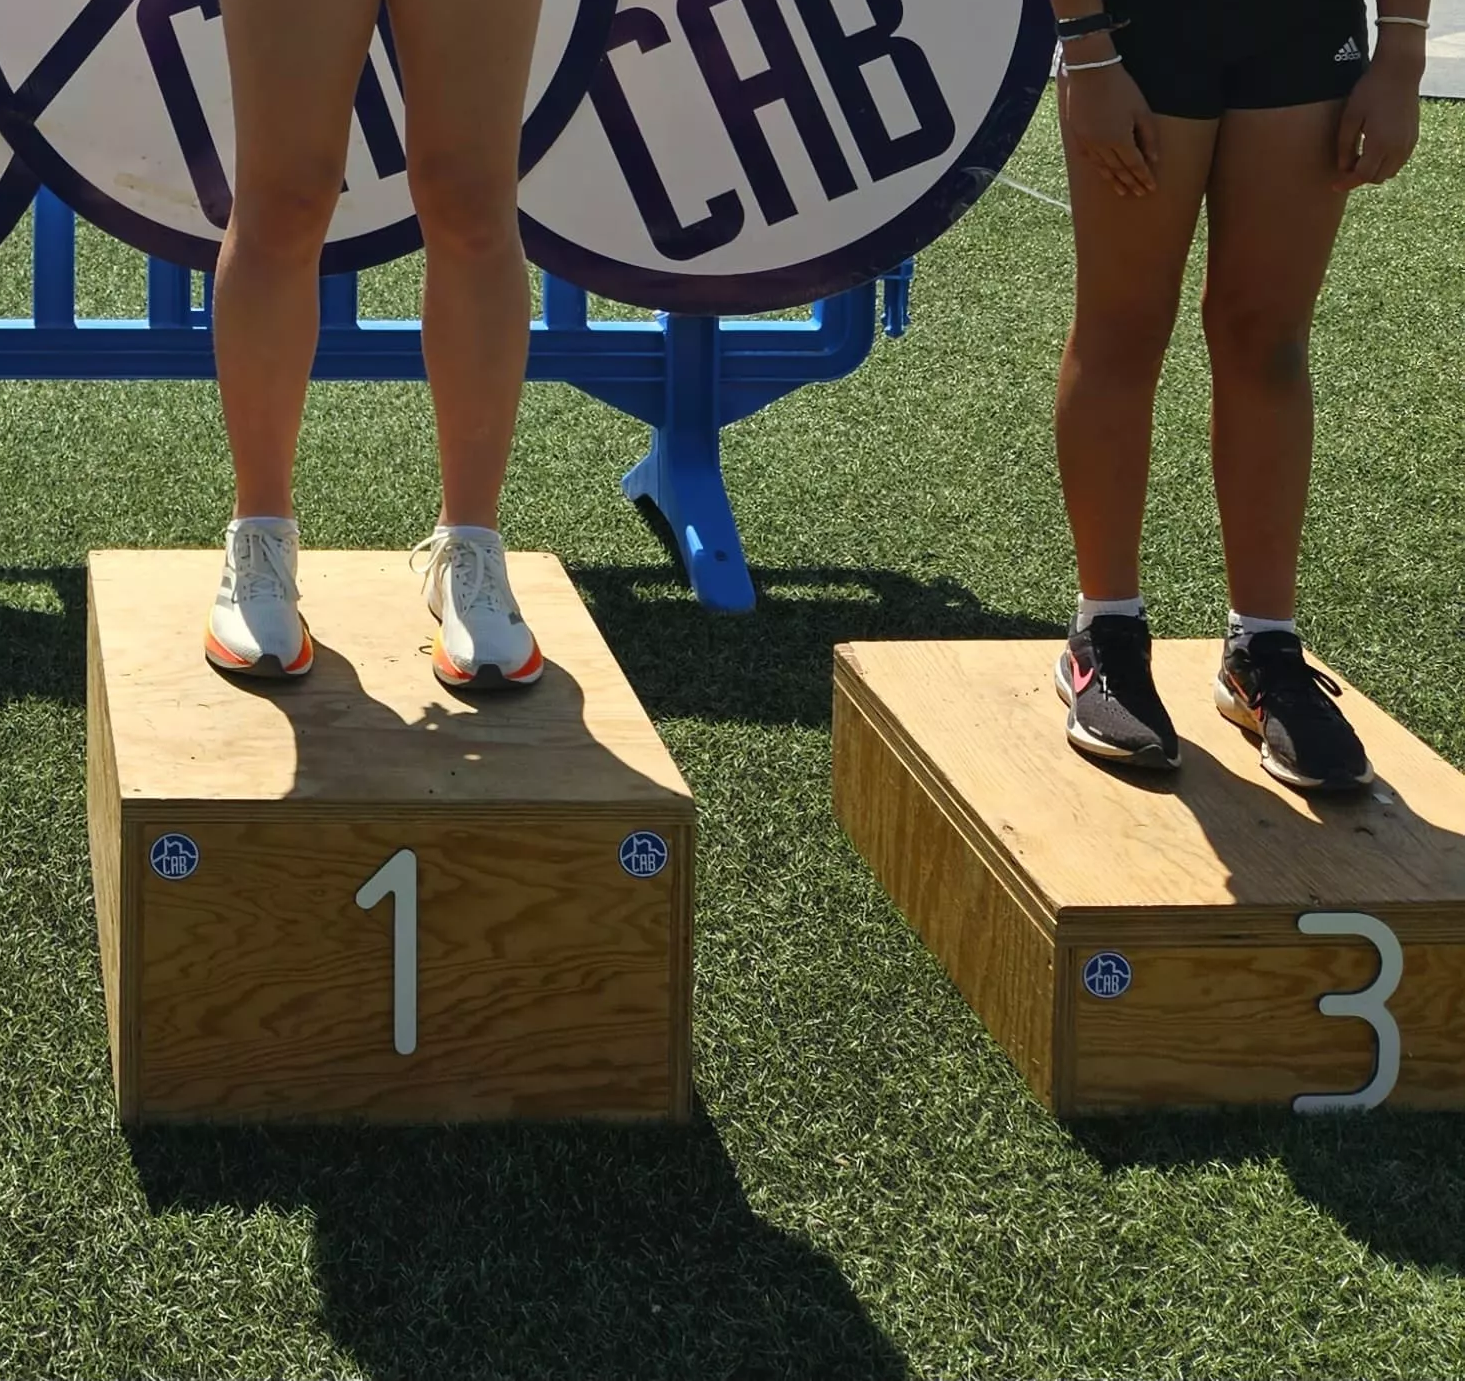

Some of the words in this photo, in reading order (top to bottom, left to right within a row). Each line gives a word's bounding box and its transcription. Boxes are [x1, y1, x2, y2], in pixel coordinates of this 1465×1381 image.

[163, 856, 187, 874] CAB
[632, 853, 655, 872] CAB
[355, 848, 417, 1056] 1
[1095, 974, 1119, 994] CAB
[1292, 912, 1404, 1113] 3
